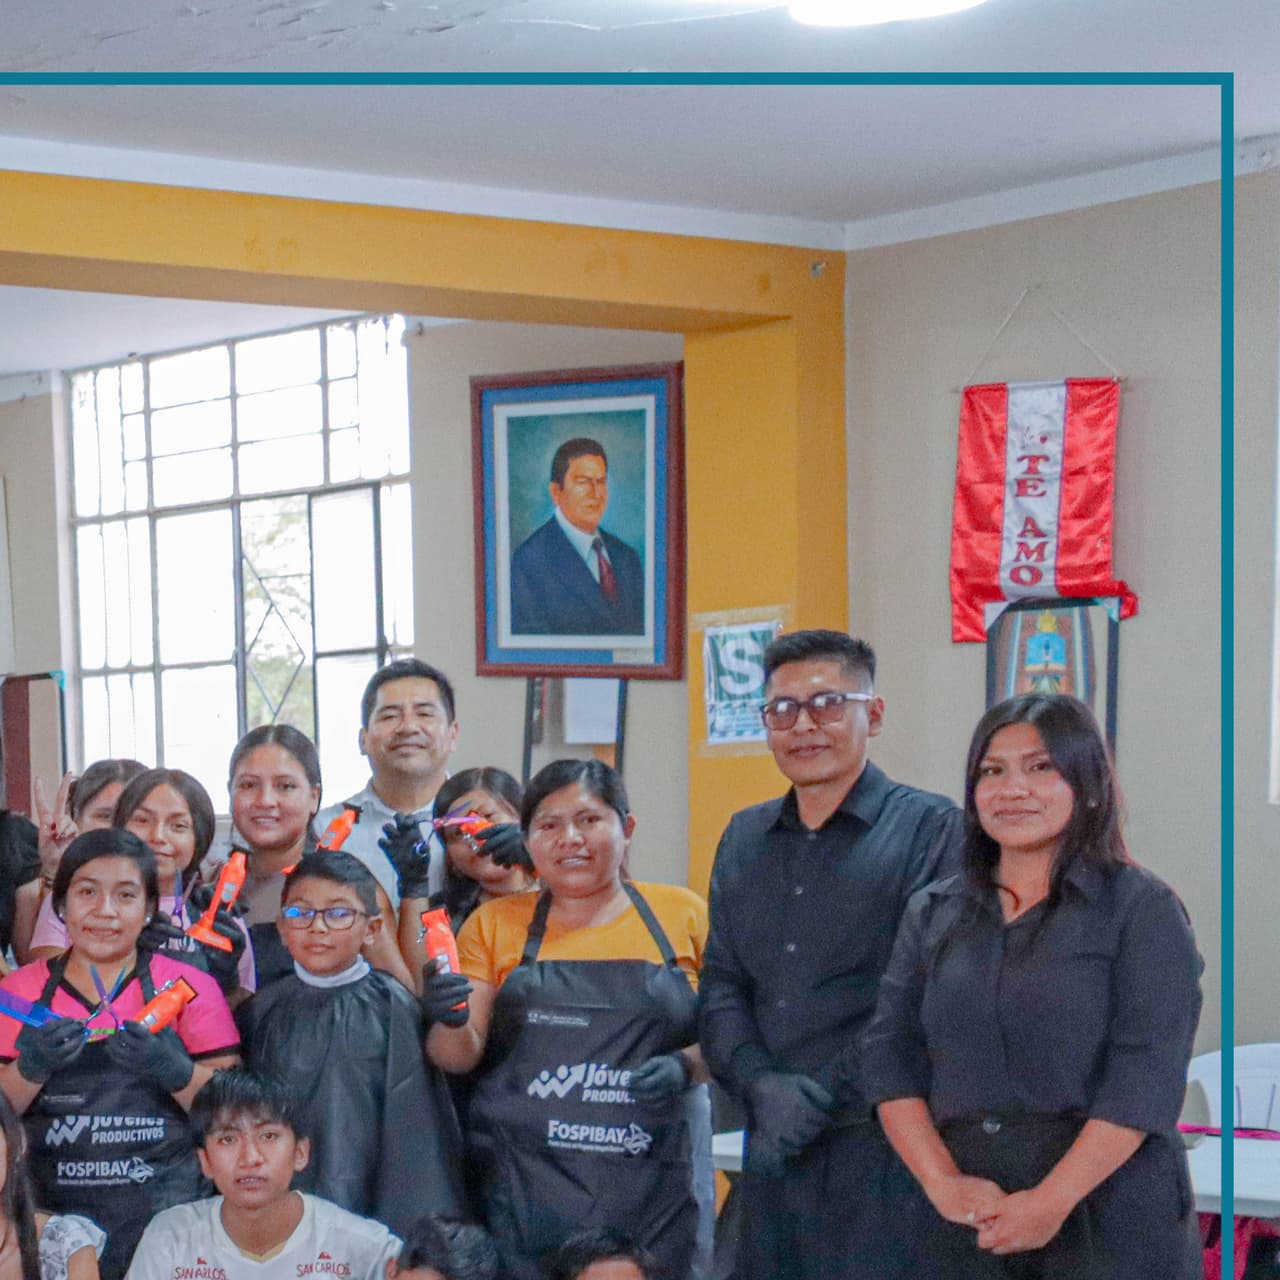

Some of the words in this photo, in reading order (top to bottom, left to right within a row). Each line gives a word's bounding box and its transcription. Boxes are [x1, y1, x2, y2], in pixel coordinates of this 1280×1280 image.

[1009, 516, 1048, 587] AMO
[719, 637, 766, 695] S
[583, 1063, 632, 1089] Jóve
[91, 1126, 164, 1145] PRODUCTIVOS
[547, 1119, 627, 1144] FOSPIBAY
